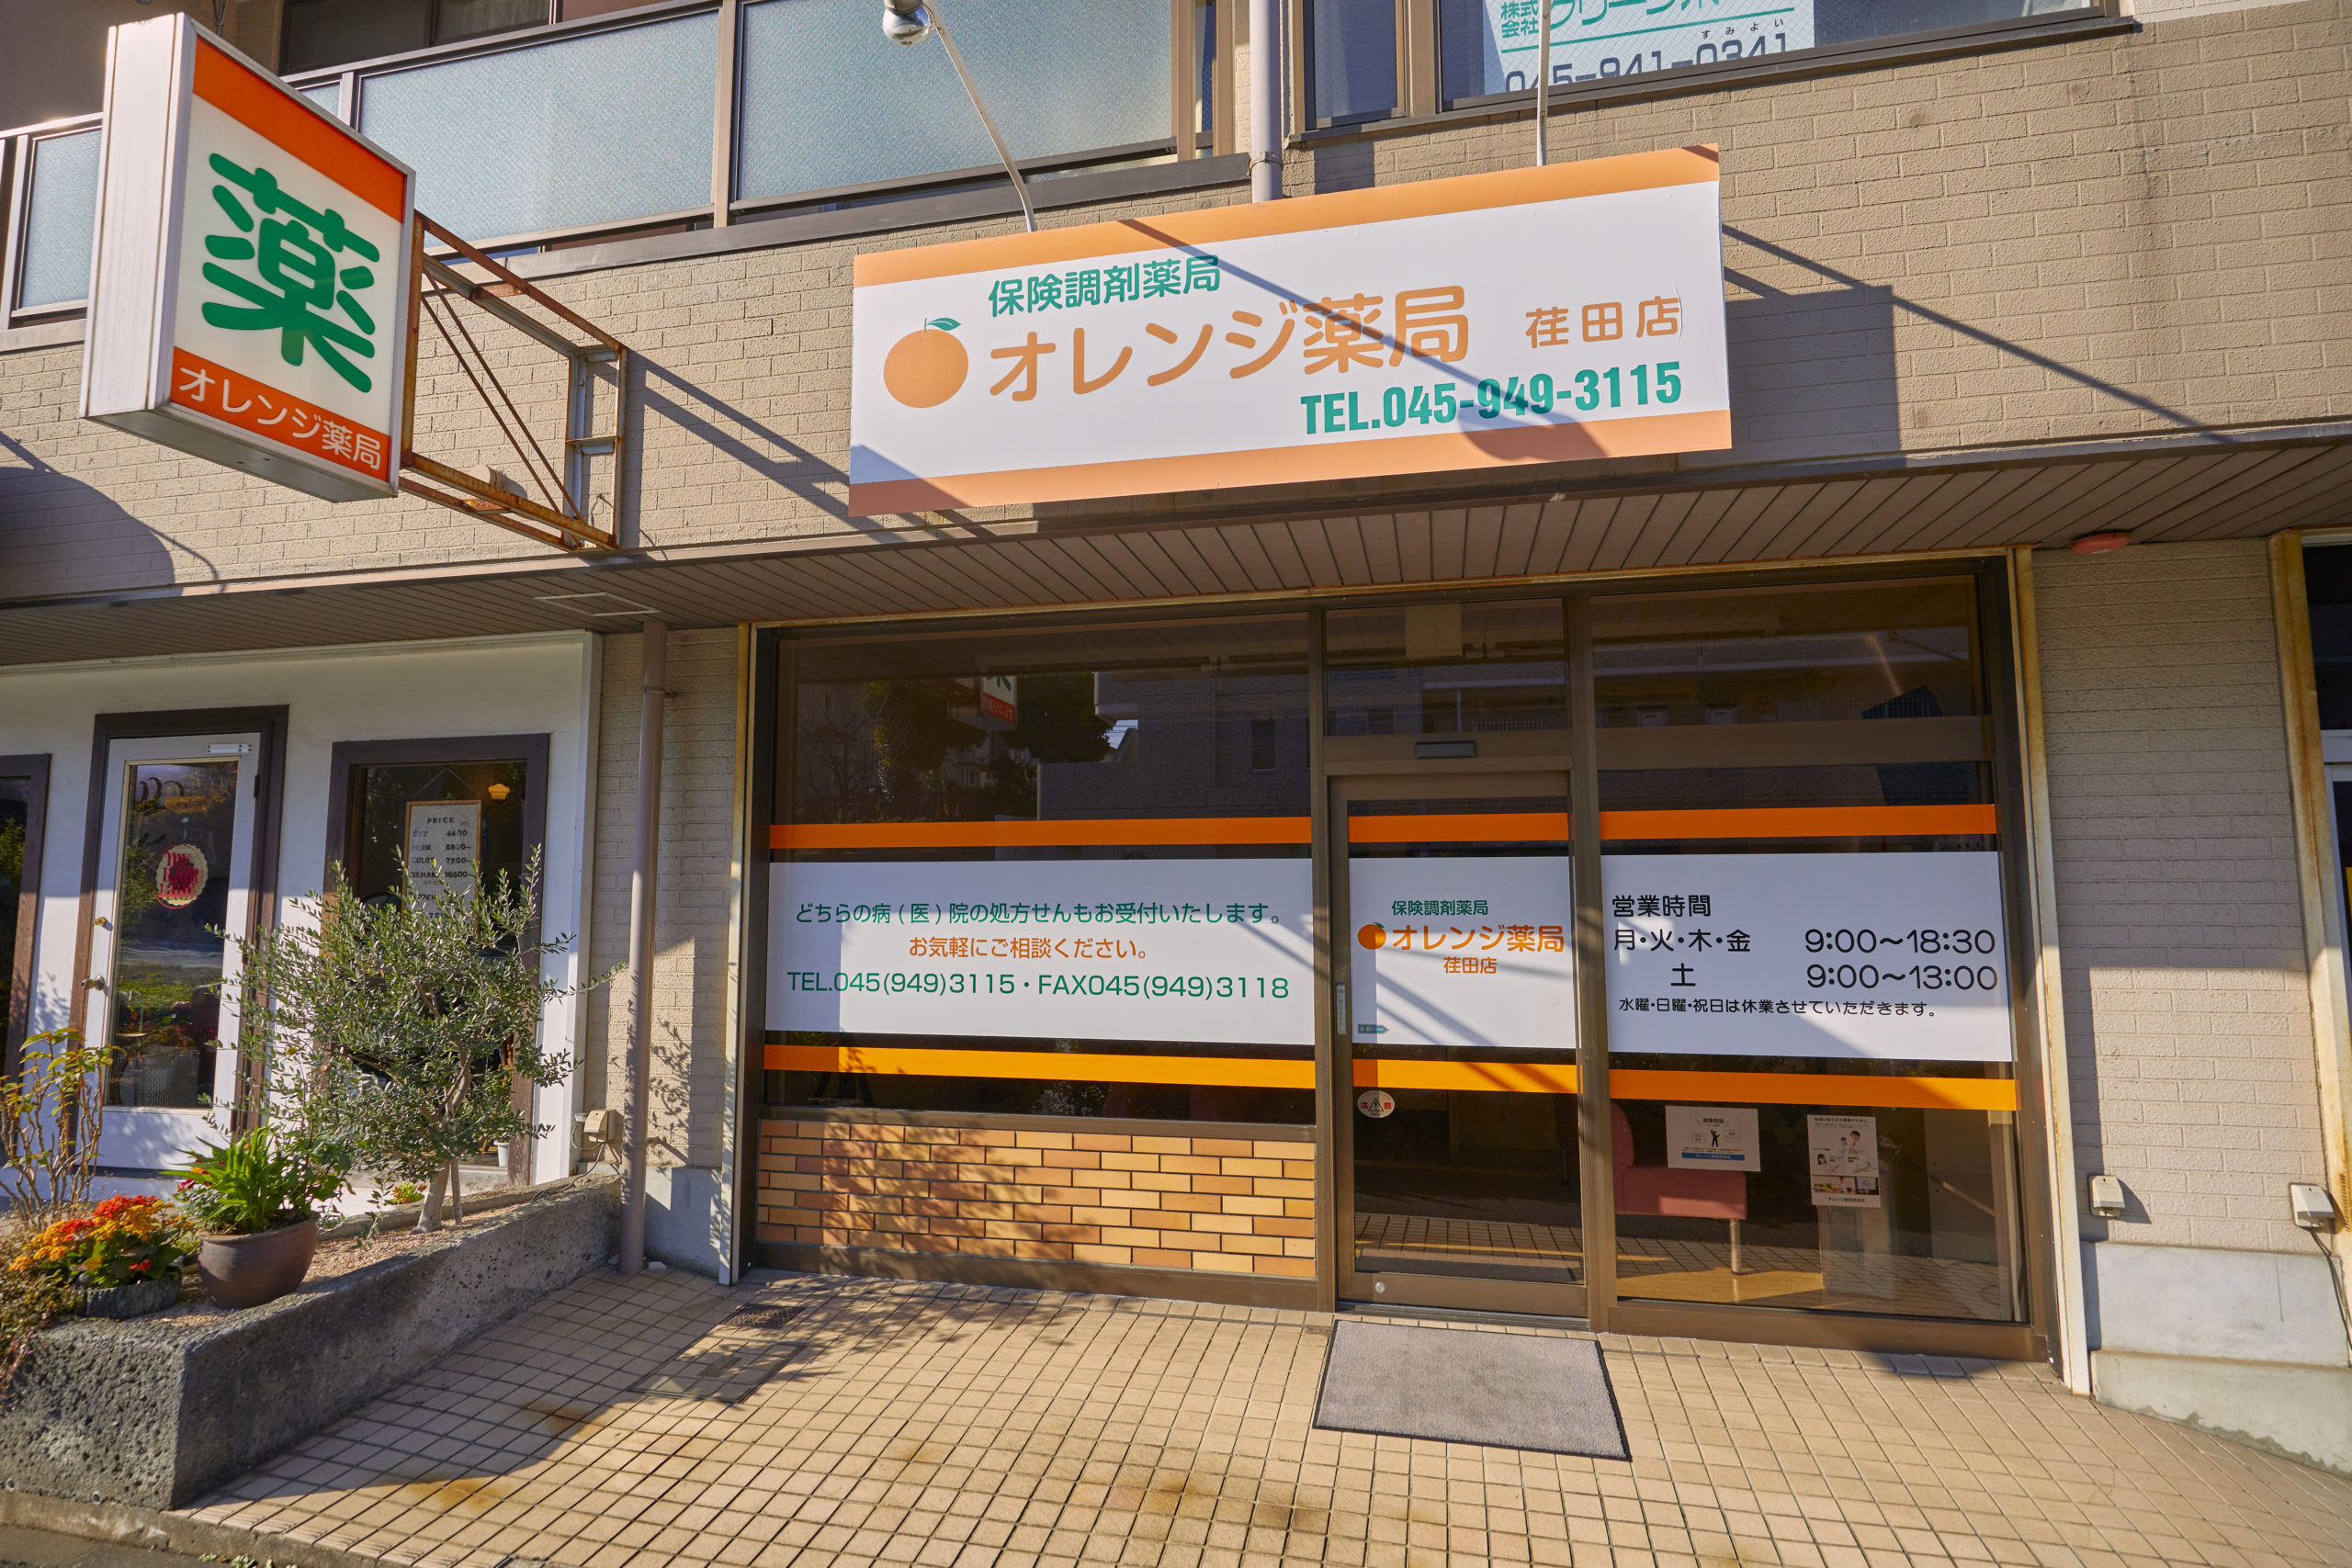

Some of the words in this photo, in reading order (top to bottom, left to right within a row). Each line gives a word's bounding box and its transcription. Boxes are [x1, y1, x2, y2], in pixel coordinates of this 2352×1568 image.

[1500, 17, 1540, 39] 会社
[1702, 18, 1784, 39] すみよい
[201, 152, 380, 393] 薬
[988, 254, 1221, 318] 保険調剤薬局
[989, 285, 1469, 402] オレンジ薬局
[1525, 295, 1682, 350] 荏田店
[1301, 360, 1682, 434] TEL.045-949-3115
[178, 367, 381, 470] オレンジ薬局
[426, 816, 455, 824] PRICE
[1391, 899, 1489, 917] 保険調剤薬局
[1611, 894, 1712, 918] 営業時間
[909, 936, 1147, 960] お気軽にご相談ください。
[1392, 924, 1565, 953] オレンジ薬局
[1443, 956, 1498, 975] 荏田店
[1670, 963, 1697, 987] 土
